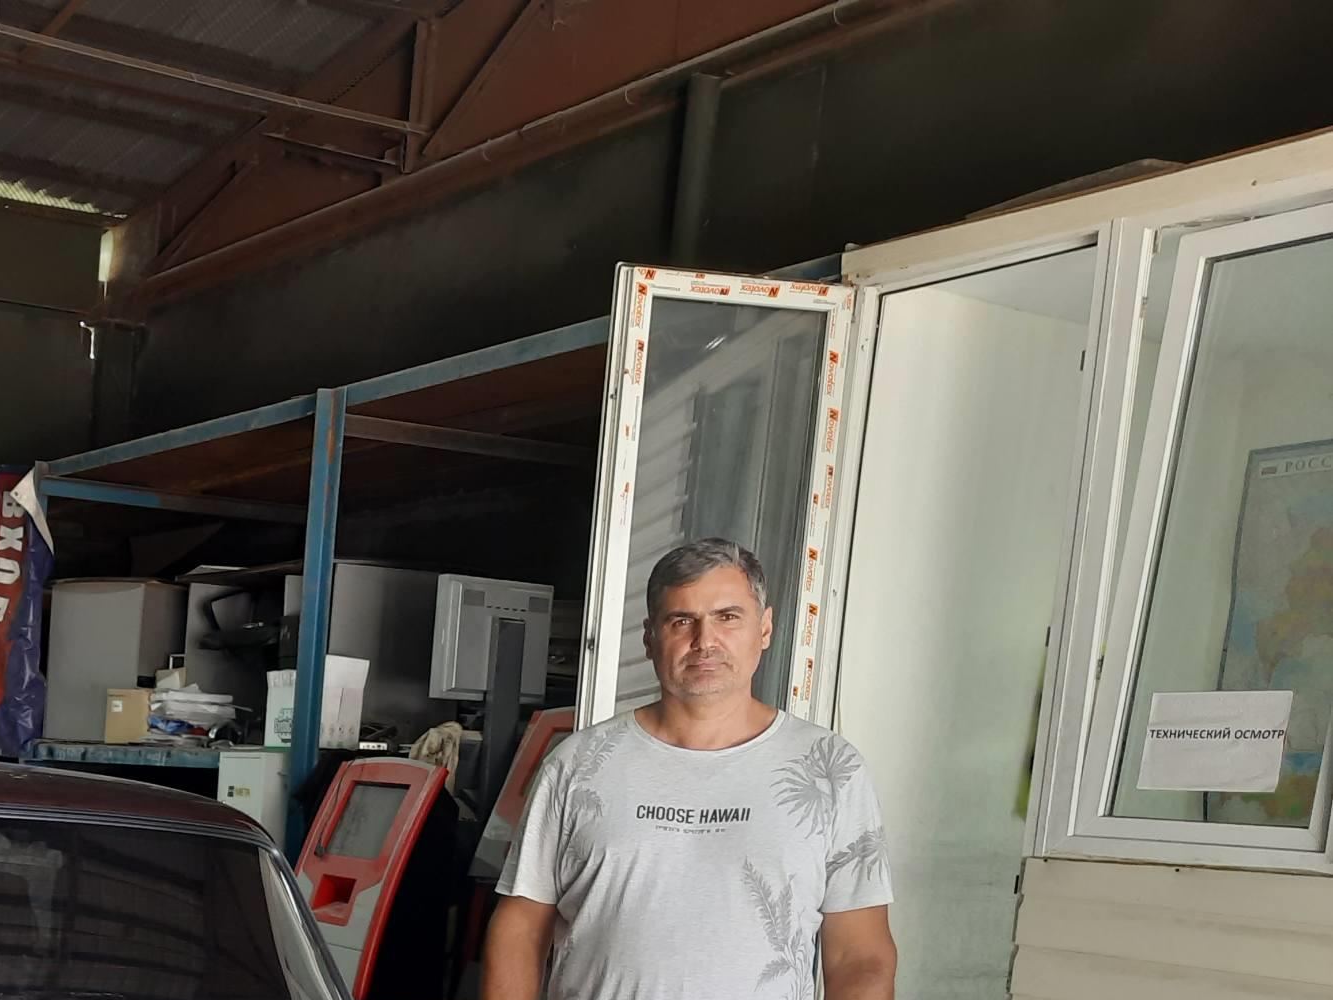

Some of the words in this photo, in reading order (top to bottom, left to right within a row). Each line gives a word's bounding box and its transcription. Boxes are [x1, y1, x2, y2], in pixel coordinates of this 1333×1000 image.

[1149, 727, 1231, 740] ТЕХНИЧЕСКИЙ
[1234, 729, 1285, 740] ОСМОТР
[636, 805, 694, 824] CHOOSE
[699, 808, 751, 824] HAWAII
